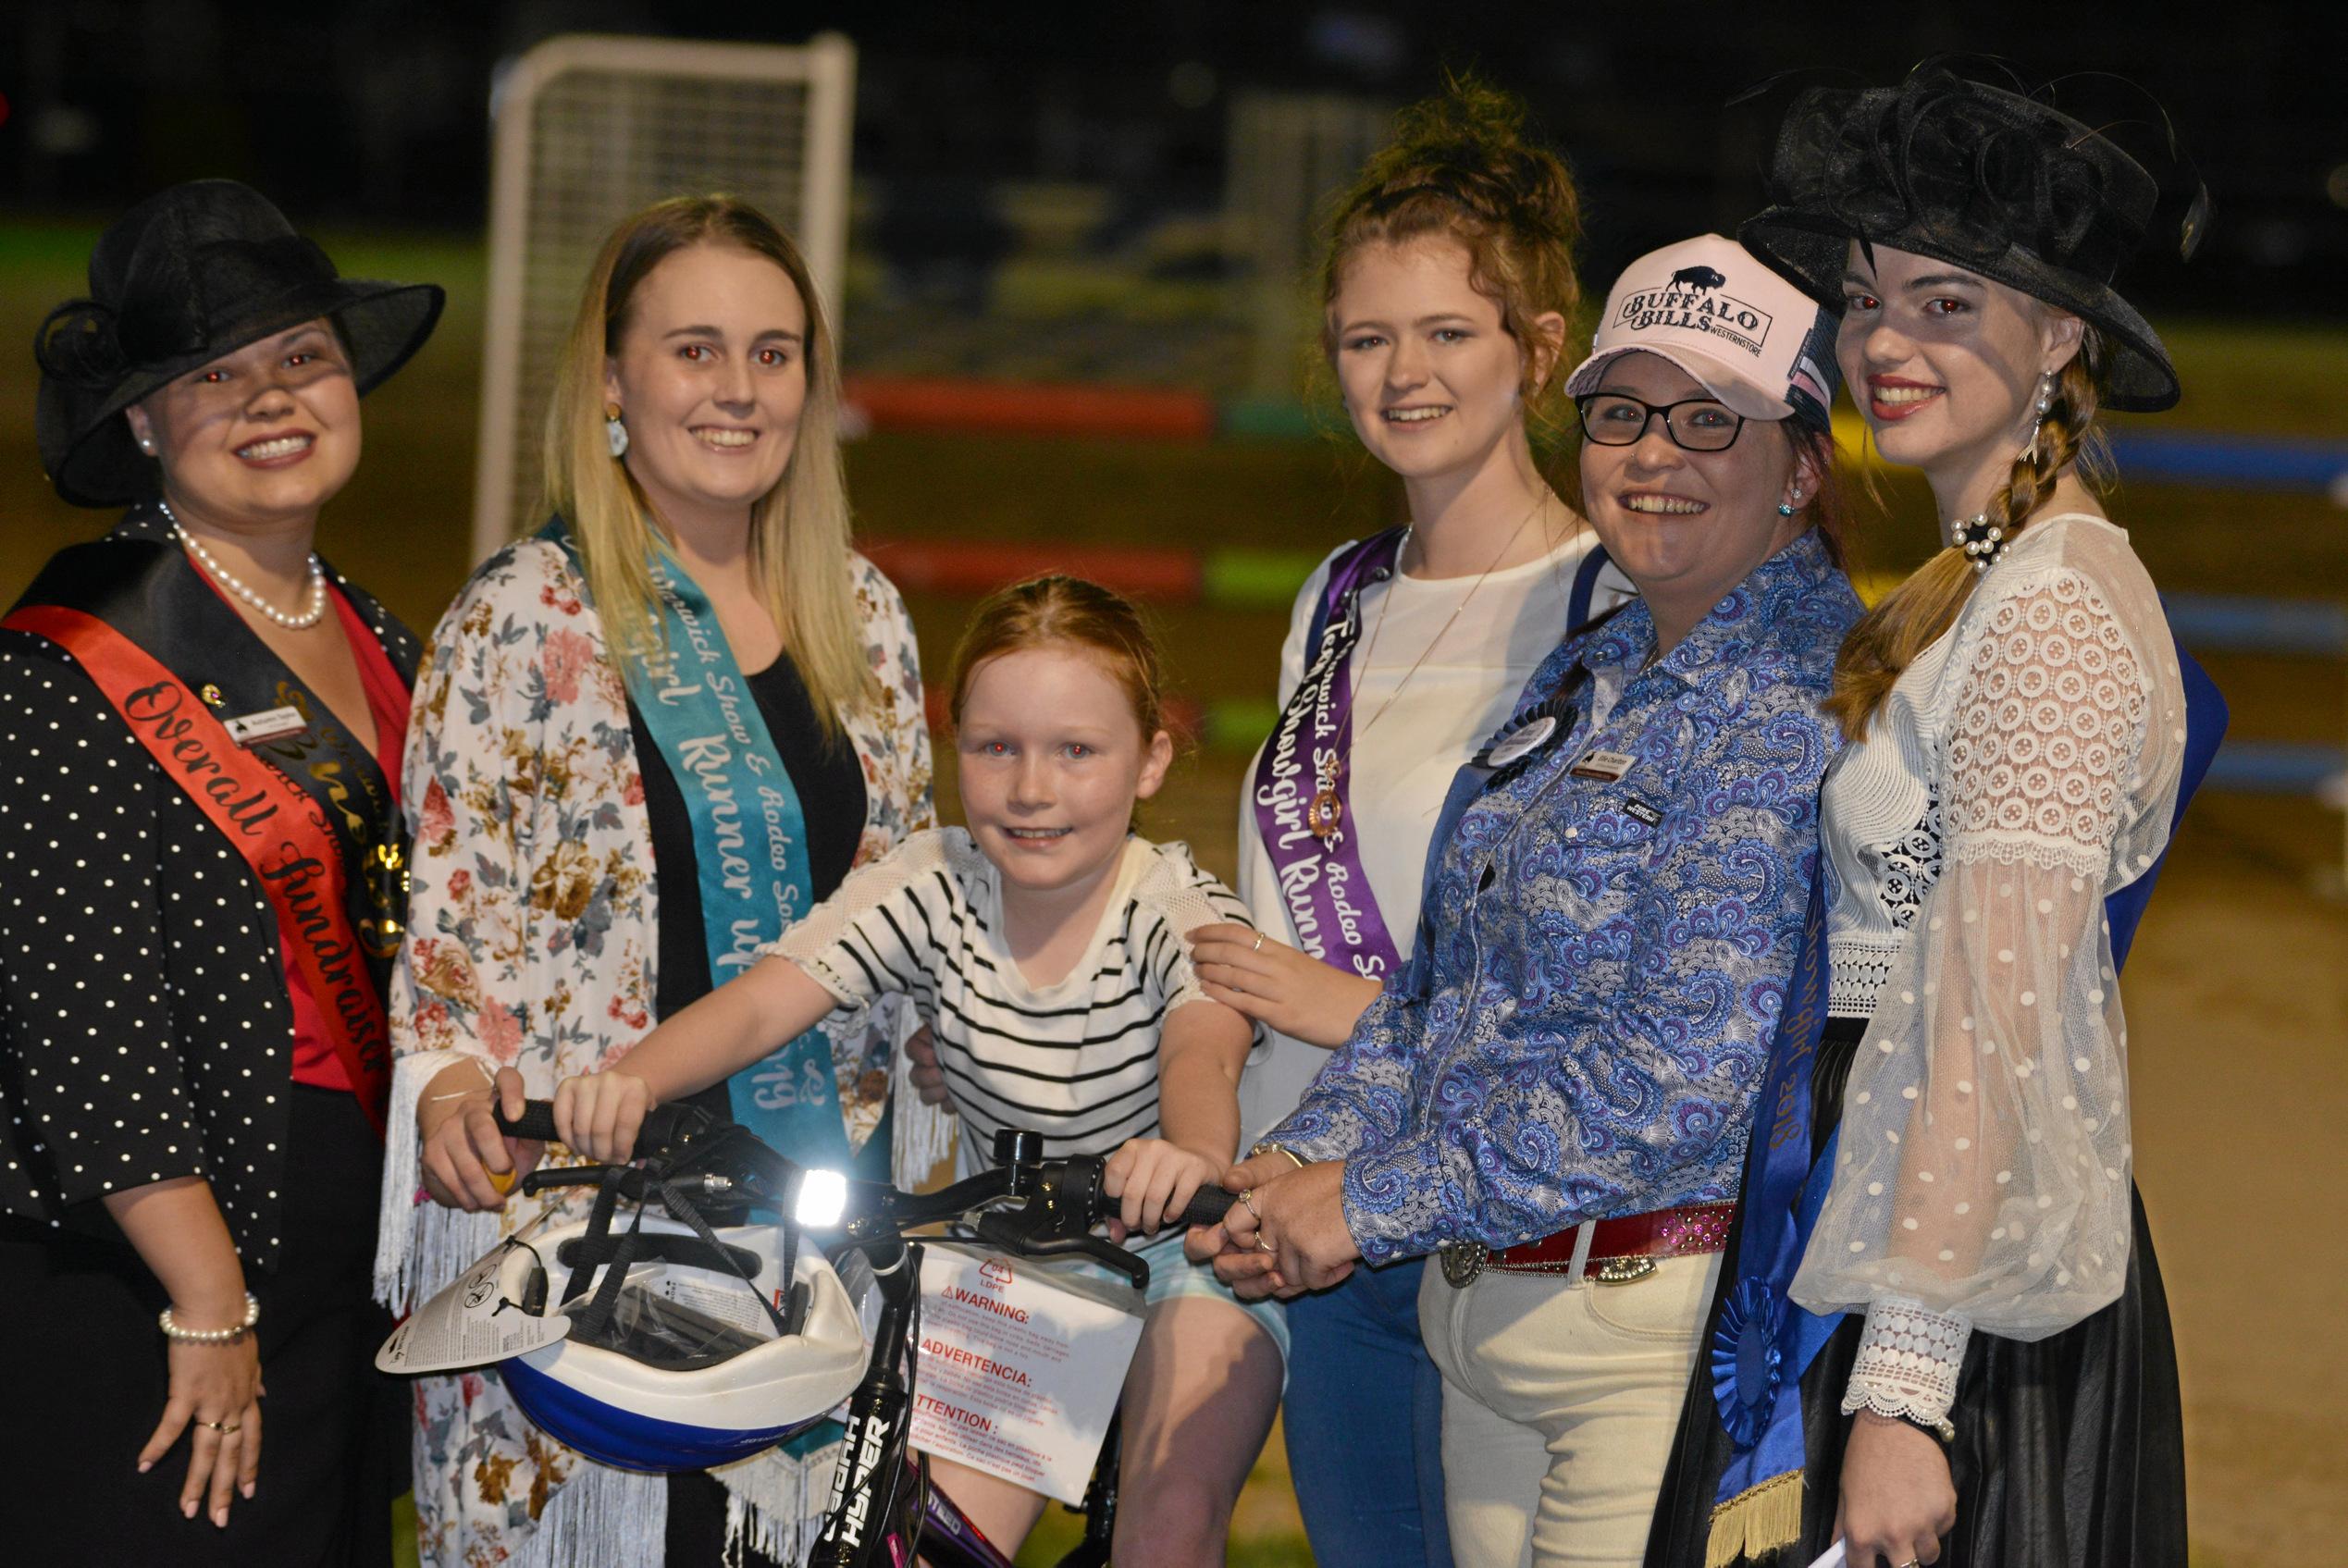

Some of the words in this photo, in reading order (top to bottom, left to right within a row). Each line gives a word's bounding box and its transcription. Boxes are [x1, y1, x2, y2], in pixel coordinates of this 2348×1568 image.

[1623, 291, 1760, 331] BUFFALO
[1631, 310, 1712, 332] BILLS
[123, 680, 279, 837] Overall
[706, 669, 751, 747] Show
[744, 751, 771, 777] &
[758, 784, 789, 870] Rodeo
[1255, 683, 1318, 850] Showgirl
[678, 734, 752, 900] Runner
[1279, 853, 1326, 960] Runn
[1326, 861, 1362, 945] Rodeo
[1768, 1072, 1801, 1151] 2018
[954, 1287, 1030, 1325] WARNING:
[979, 1278, 1005, 1294] LDPE
[990, 1264, 1005, 1274] 04
[921, 1338, 1032, 1388] ADVERTENCIA:
[917, 1393, 993, 1432] TTENTION
[841, 1415, 890, 1548] HYPER
